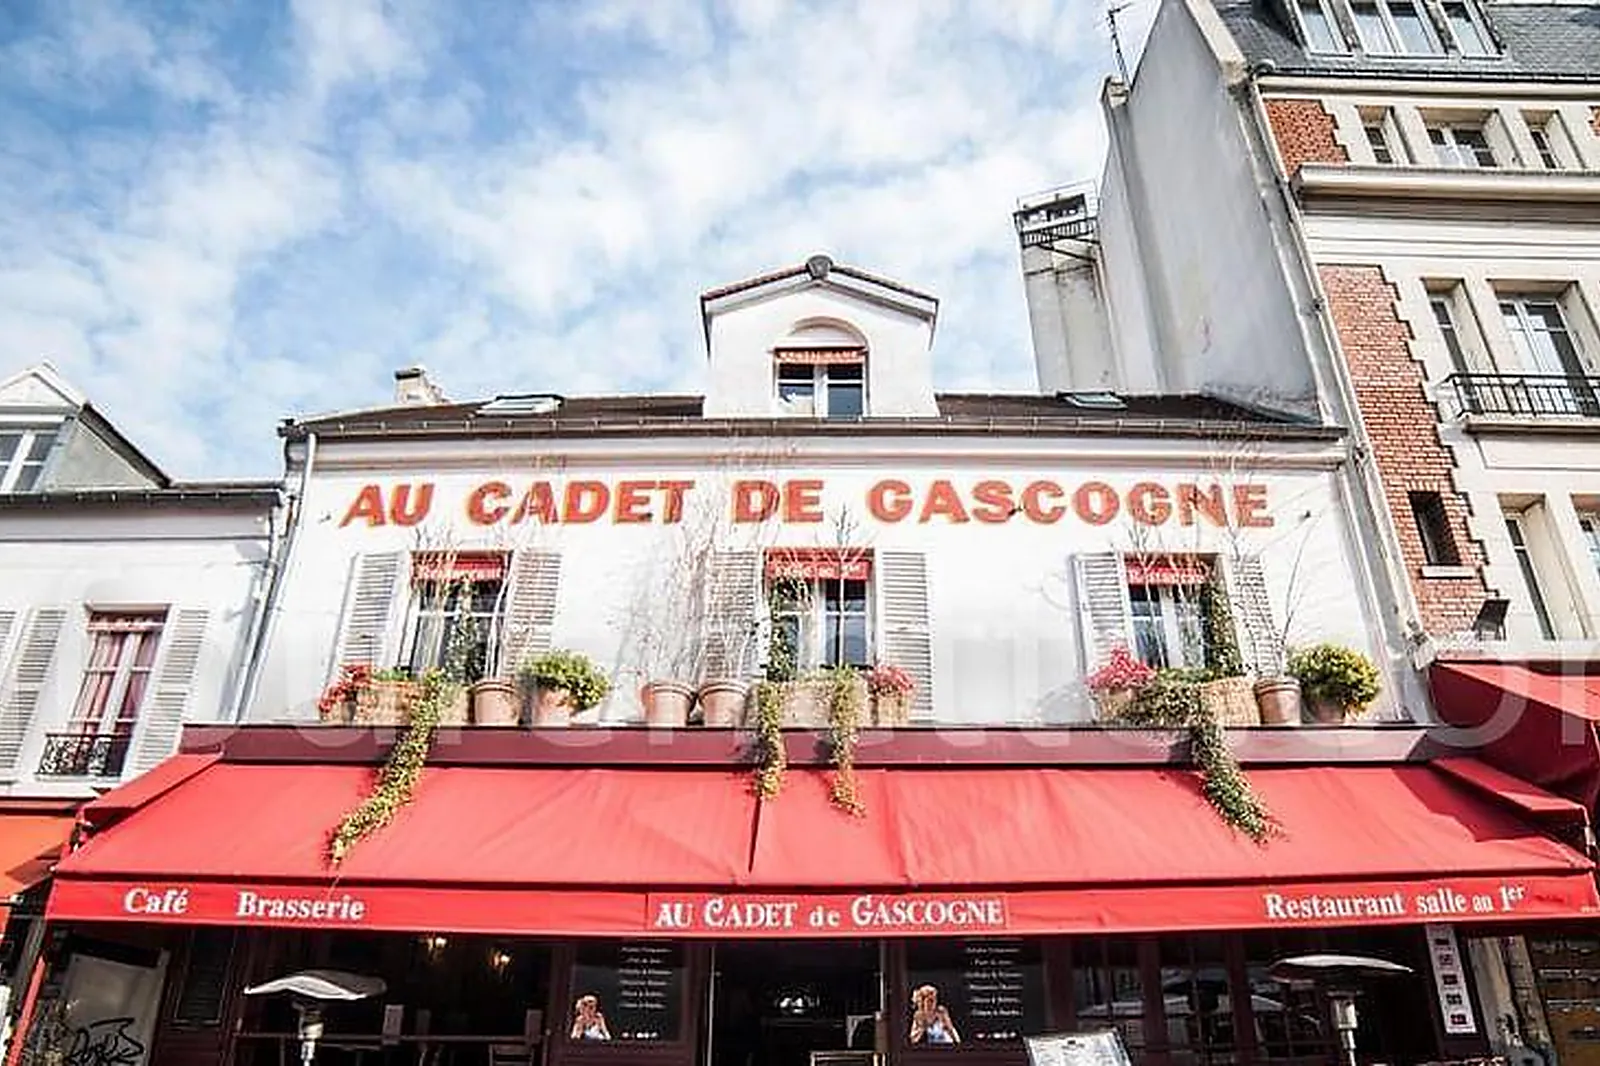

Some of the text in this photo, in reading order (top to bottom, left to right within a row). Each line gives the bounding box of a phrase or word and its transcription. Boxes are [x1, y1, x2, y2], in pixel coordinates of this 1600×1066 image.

[338, 479, 1274, 528] AU CADET DE GASCOGNE
[123, 887, 365, 919] Café Brasserie
[655, 895, 1004, 928] AU CADET de GASCOGNE
[1263, 885, 1526, 920] Restaurant salle au 1er
